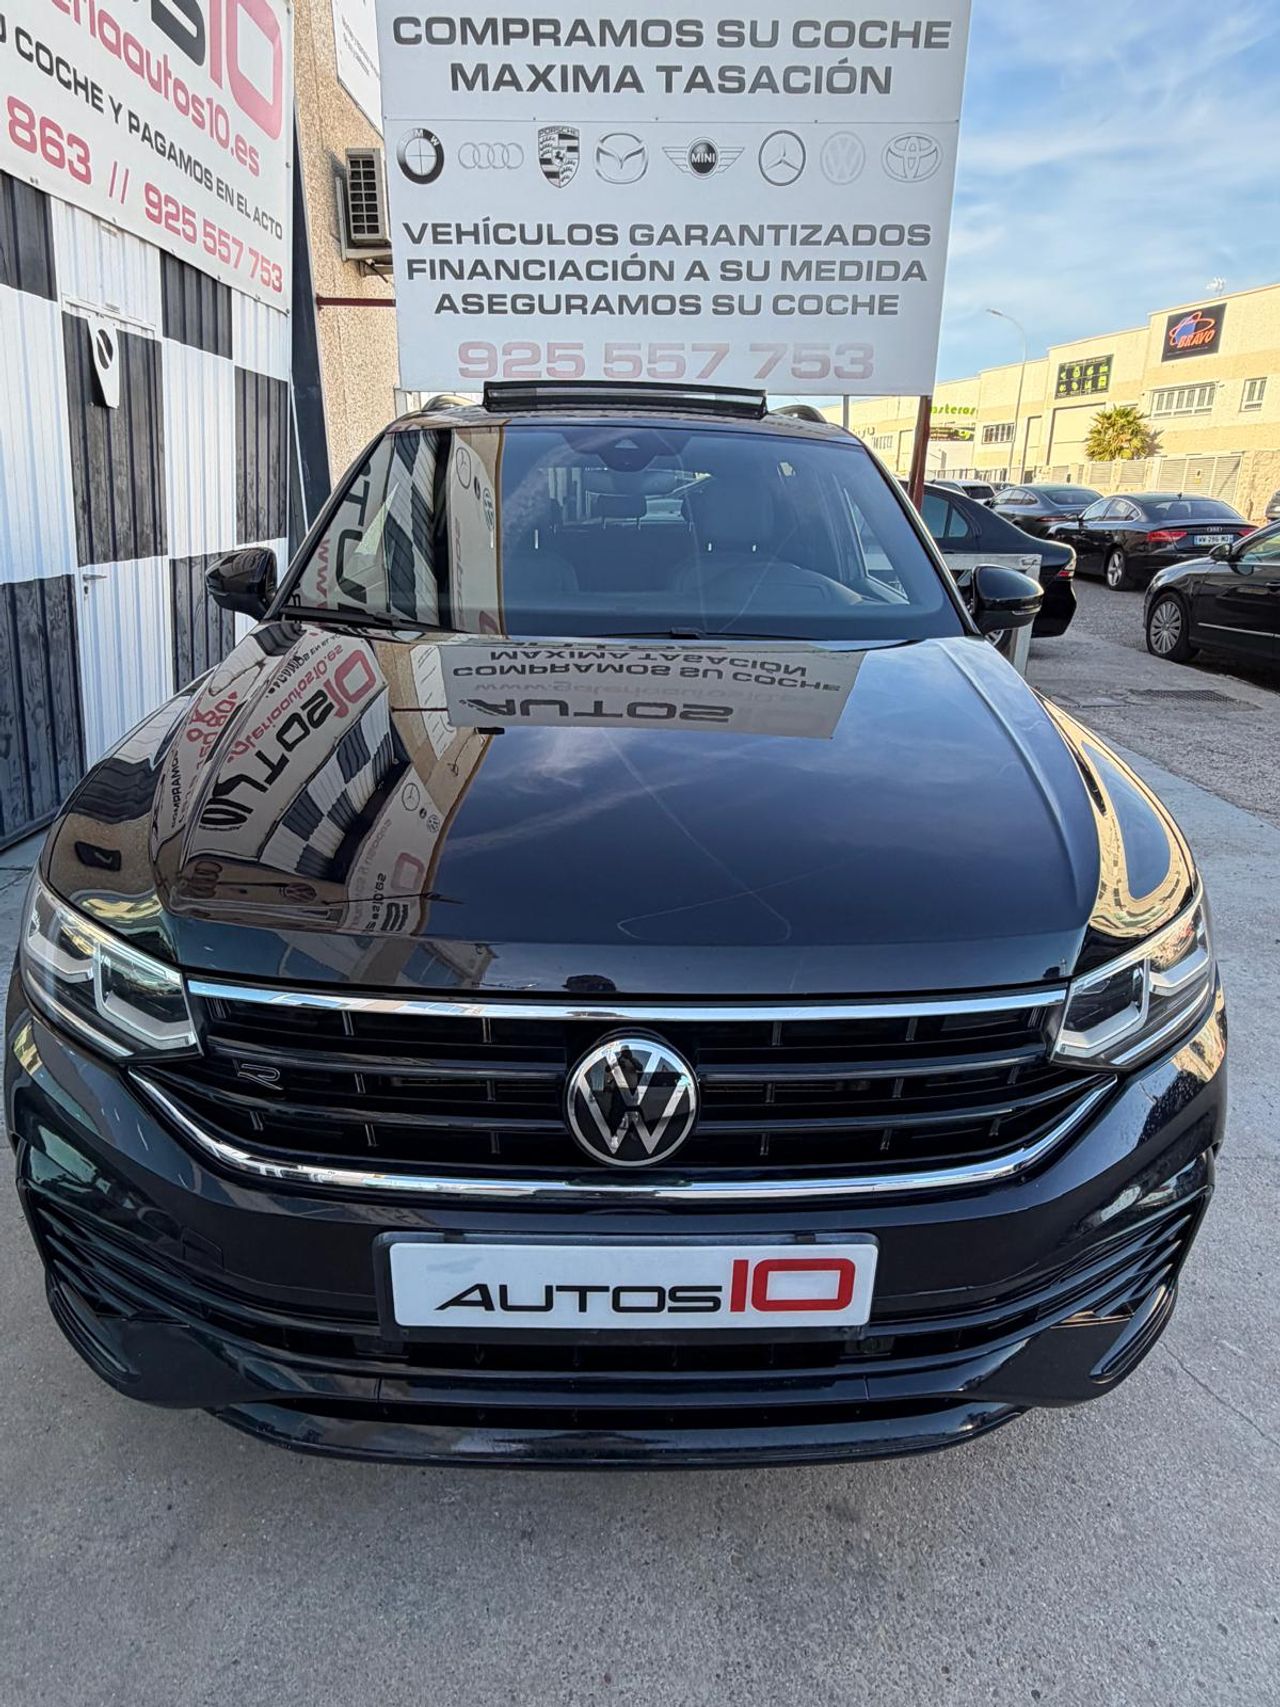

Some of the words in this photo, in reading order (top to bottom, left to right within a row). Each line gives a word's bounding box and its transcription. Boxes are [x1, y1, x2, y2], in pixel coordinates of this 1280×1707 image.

[393, 16, 704, 48] COMPRAMOS
[716, 19, 779, 49] SU
[791, 20, 951, 50] COCHE
[450, 63, 645, 93] MAXIMA
[656, 58, 892, 95] TASACIÓN
[15, 26, 104, 114] COCHE
[108, 95, 123, 124] Y
[128, 111, 214, 193] PAGAMOS
[216, 179, 235, 207] EN
[236, 192, 252, 219] EL
[252, 206, 283, 240] ACTO
[690, 152, 717, 165] MINI
[7, 96, 92, 185] 863
[144, 182, 198, 246] 925
[202, 218, 244, 270] 557
[248, 247, 283, 293] 753
[402, 216, 620, 247] VEHÍCULOS
[629, 223, 932, 247] GARANTIZADOS
[406, 253, 676, 282] FINANCIACIÓN
[684, 260, 711, 282] A
[720, 260, 771, 282] SU
[780, 259, 927, 282] MEDIDA
[434, 293, 702, 316] ASEGURAMOS
[711, 293, 762, 316] SU
[772, 294, 899, 316] COCHE
[458, 341, 586, 380] 925
[602, 342, 731, 380] 557
[748, 342, 875, 380] 753
[434, 1257, 856, 1314] AUTOS10
